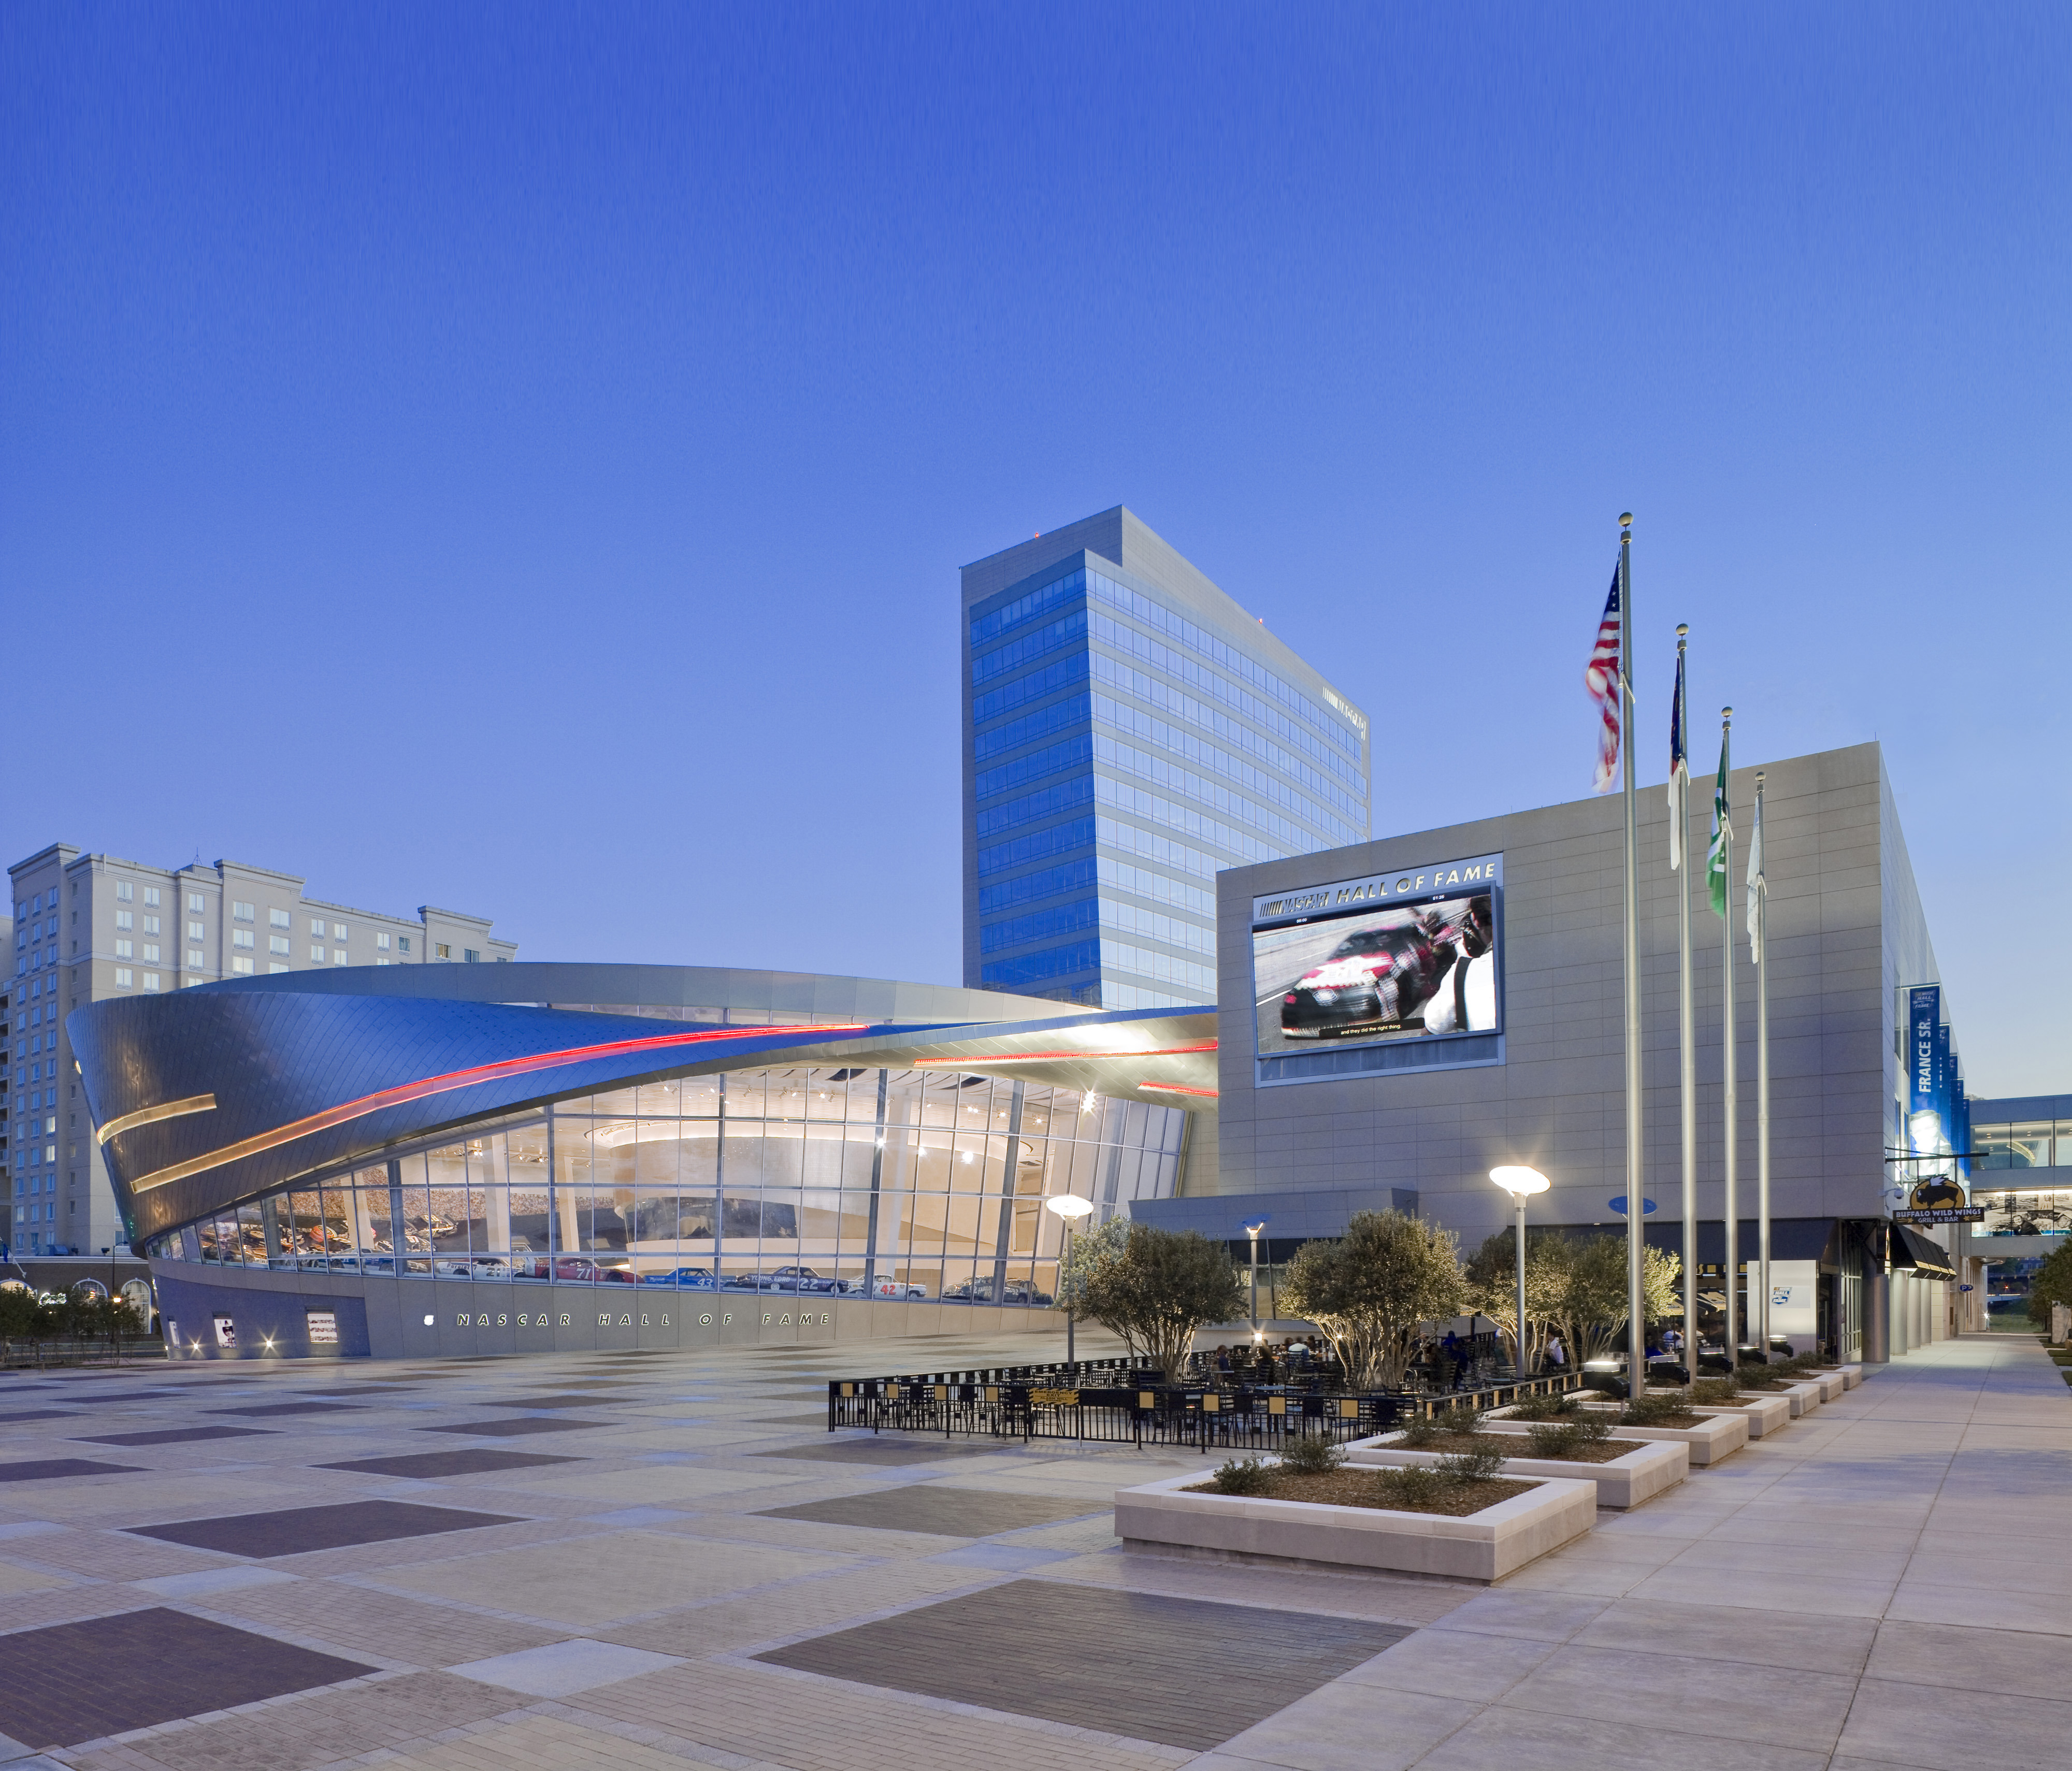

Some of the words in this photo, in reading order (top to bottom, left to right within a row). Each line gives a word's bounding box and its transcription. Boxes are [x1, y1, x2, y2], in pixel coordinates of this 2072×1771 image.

[1280, 891, 1330, 914] NASCAR
[1336, 882, 1388, 904] HALL
[1395, 875, 1424, 893] OF
[1434, 862, 1495, 887] FAME
[1918, 1018, 1931, 1038] SR.
[1918, 1042, 1931, 1092] FRANCE
[486, 1268, 500, 1277] 21
[577, 1268, 592, 1279] 71
[697, 1278, 713, 1287] 43
[799, 1277, 819, 1290] 22
[880, 1285, 897, 1295] 42
[457, 1314, 570, 1326] NASCAR
[598, 1314, 669, 1325] HALL
[699, 1314, 732, 1325] OF
[762, 1314, 829, 1324] FAME
